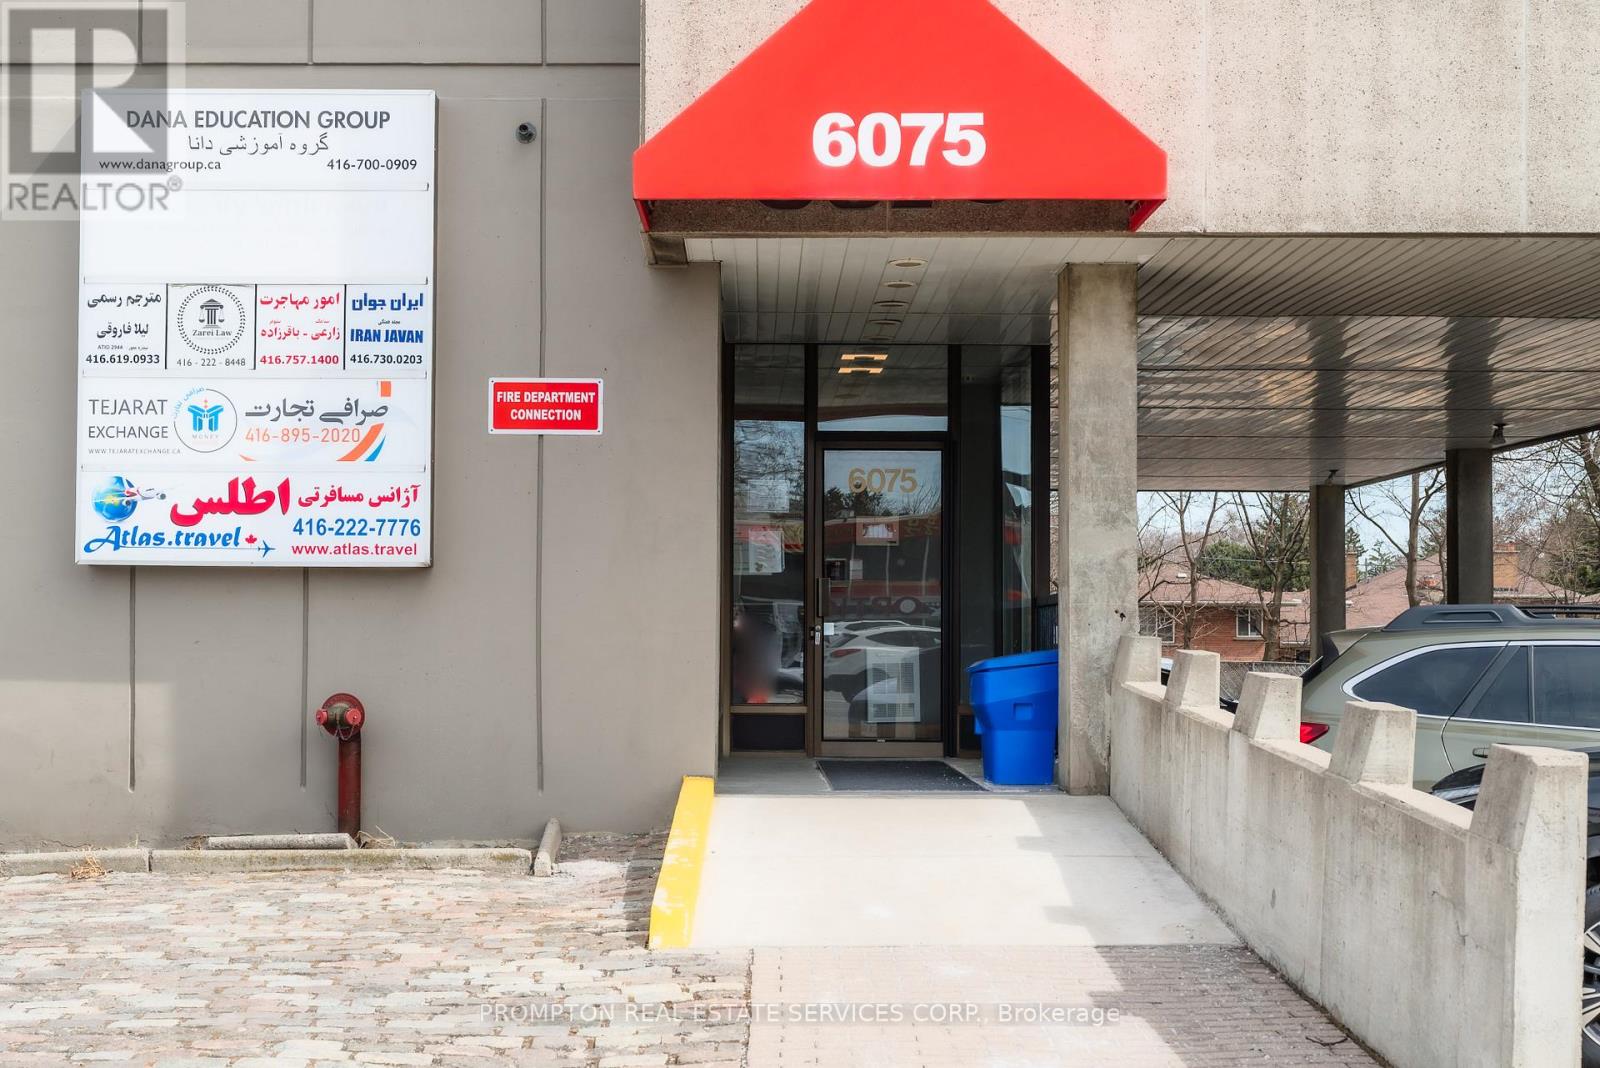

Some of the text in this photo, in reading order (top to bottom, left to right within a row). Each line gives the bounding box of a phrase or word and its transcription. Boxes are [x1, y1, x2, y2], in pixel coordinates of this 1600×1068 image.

[126, 110, 391, 129] DANA EDUCATION GROUP
[188, 132, 330, 156] گروه آموزشی دانا
[812, 112, 987, 167] 6075
[99, 157, 222, 172] www.danagroup.ca
[326, 159, 418, 171] 416-700-0909
[87, 292, 162, 308] مترجم رسمی
[259, 292, 341, 310] امور مهاجرت
[351, 292, 424, 311] ایران جوان
[96, 321, 149, 339] لیلا فاروقی
[192, 329, 233, 337] Zarei Law
[260, 325, 300, 341] باقرزاده
[310, 326, 341, 341] زارعی
[350, 328, 424, 343] IRAN JAVAN
[86, 354, 160, 364] 416.619.0933
[176, 358, 192, 367] 416
[201, 358, 217, 367] 222
[225, 358, 246, 367] 8448
[259, 354, 339, 365] 416.757.1400
[350, 354, 423, 364] 416.730.0203
[496, 391, 596, 403] FIRE DEPARTMENT
[88, 399, 168, 415] TEJARAT
[245, 396, 389, 425] صرافی تجارت
[510, 408, 582, 421] CONNECTION
[88, 425, 169, 439] EXCHANGE
[245, 427, 361, 444] 416-895-2020
[848, 468, 918, 494] 6075
[169, 476, 291, 527] اطلس
[298, 483, 421, 508] آژانس مسافرتی
[292, 518, 421, 537] 416-222-7776
[83, 525, 242, 553] Atlas.travel
[291, 542, 417, 556] www.atlas.travel
